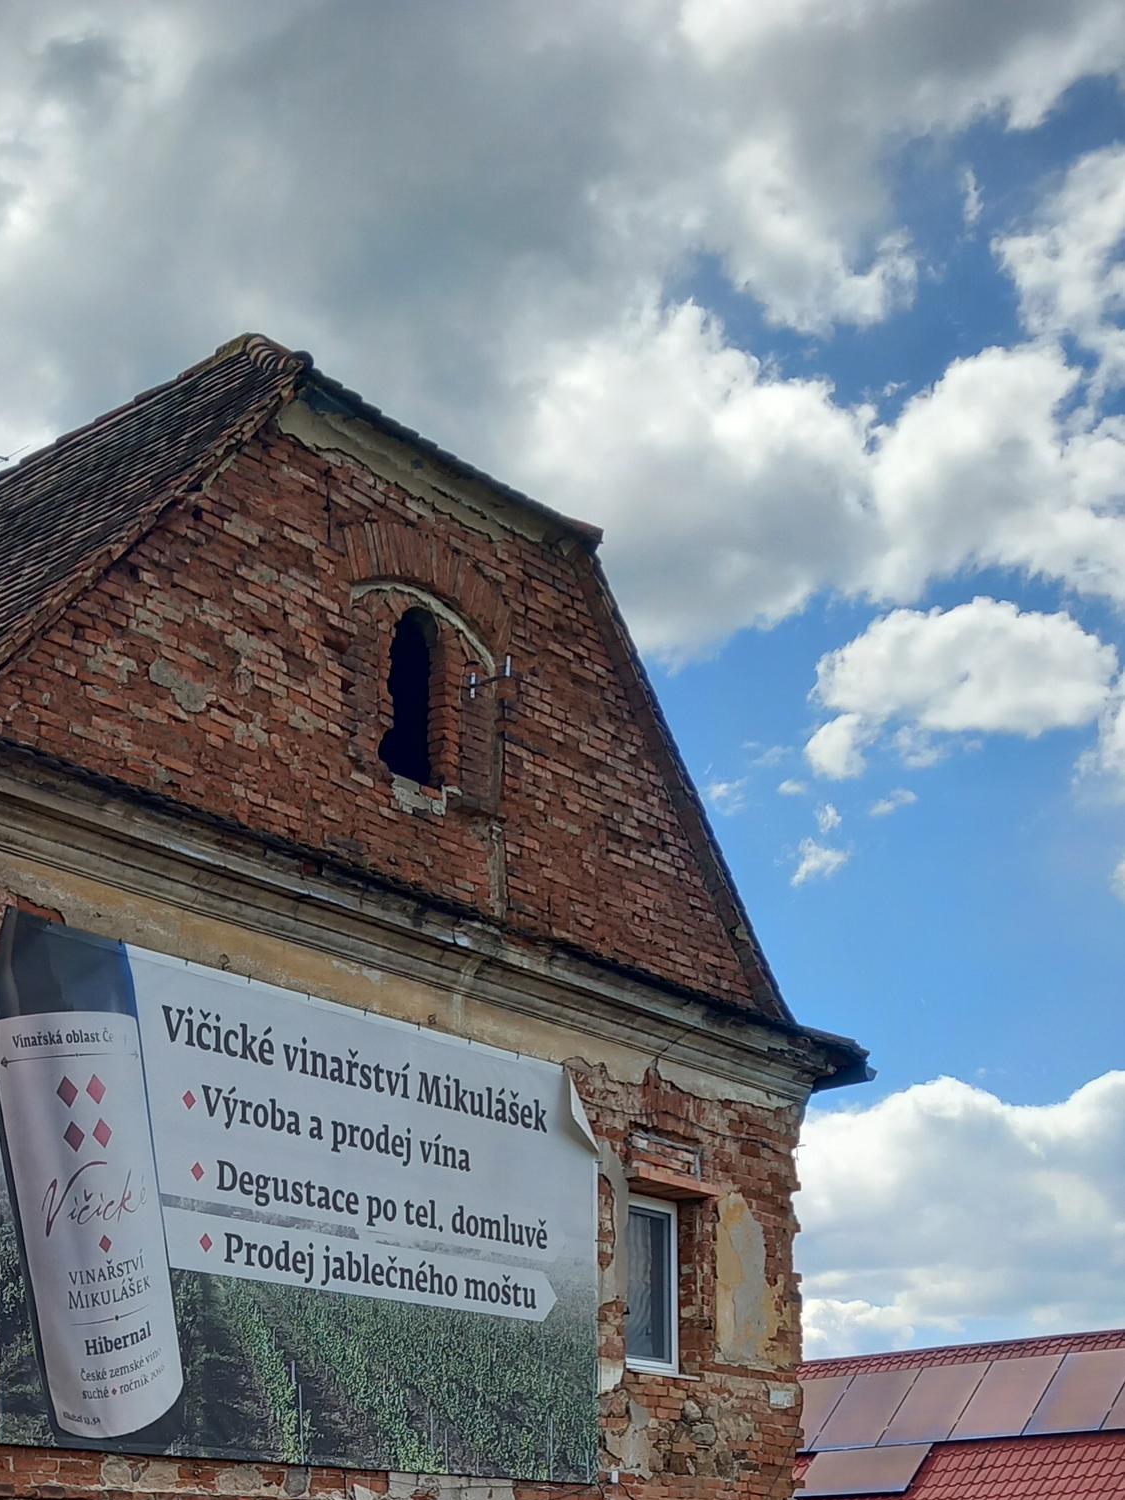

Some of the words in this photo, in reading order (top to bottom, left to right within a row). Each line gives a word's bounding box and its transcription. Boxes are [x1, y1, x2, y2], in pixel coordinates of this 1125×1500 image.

[12, 1029, 63, 1049] Vinařská
[66, 1030, 100, 1044] oblast
[161, 1004, 275, 1066] Vičické
[283, 1036, 410, 1100] vinařství
[416, 1071, 548, 1133] Mikulášek
[201, 1084, 301, 1136] Výroba
[309, 1115, 324, 1140] a
[331, 1120, 412, 1167] prodej
[419, 1134, 471, 1172] vína
[217, 1160, 360, 1215] Degustace
[366, 1194, 397, 1226] po
[404, 1200, 443, 1233] tel.
[451, 1205, 548, 1250] domluvě
[69, 1249, 144, 1285] VINAŘSTVÍ
[224, 1233, 315, 1284] Prodej
[321, 1245, 458, 1297] jablečného
[464, 1274, 537, 1309] moštu
[84, 1321, 152, 1356] Hibernal
[82, 1386, 109, 1400] suché
